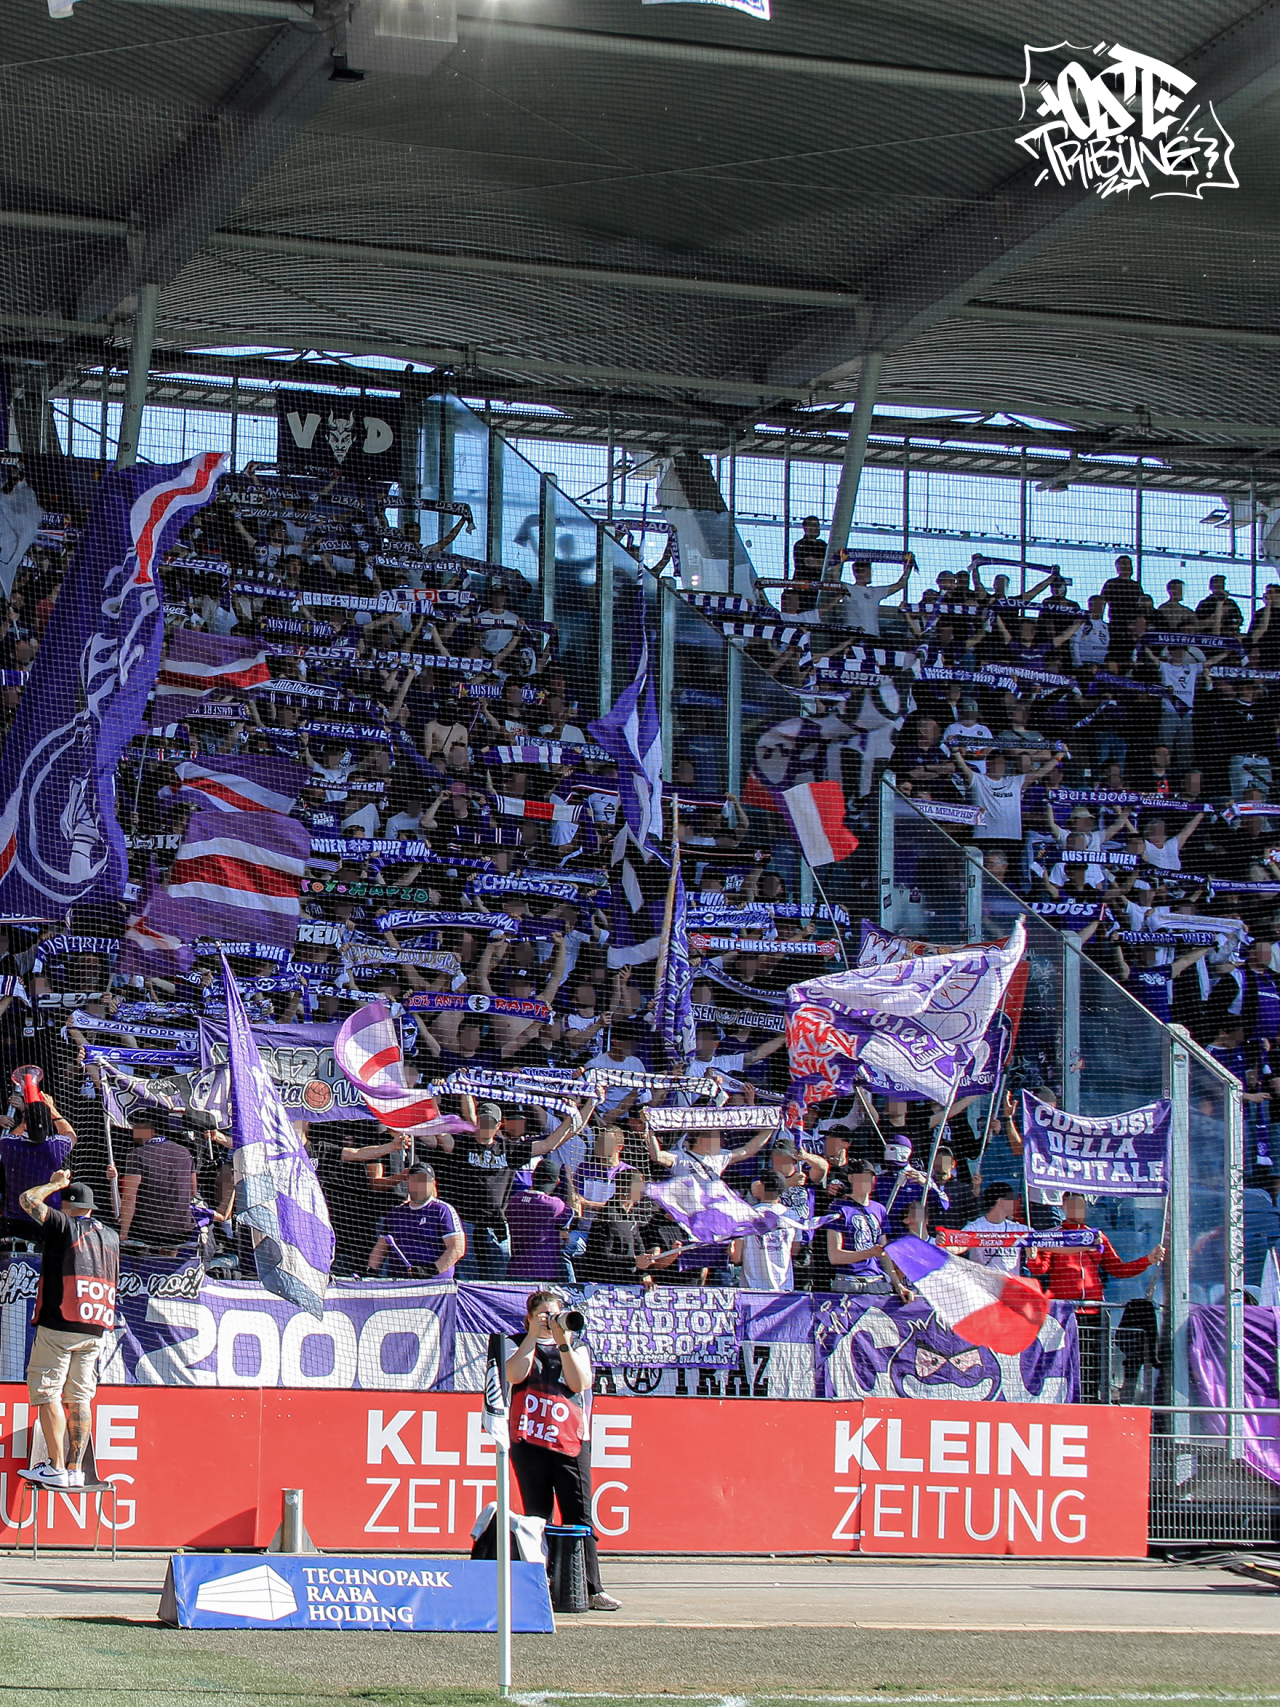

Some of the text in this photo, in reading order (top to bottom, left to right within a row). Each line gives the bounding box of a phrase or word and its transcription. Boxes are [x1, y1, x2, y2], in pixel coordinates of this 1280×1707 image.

[1157, 634, 1197, 646] AUSTRIA
[304, 646, 355, 659] AUST
[303, 722, 358, 736] USTRIA
[1062, 850, 1138, 866] AUSTRIA WIEN
[1030, 902, 1097, 917] LDOGS
[435, 995, 465, 1008] ANTI
[1033, 1104, 1157, 1139] CONFUSI
[1047, 1128, 1138, 1160] DELLA
[1030, 1152, 1165, 1183] CAPITALE
[76, 1278, 117, 1301] FOO
[589, 1287, 738, 1311] GEGEN
[586, 1308, 739, 1334] STADION
[135, 1298, 443, 1391] 2000
[587, 1332, 739, 1356] VERBOTE
[524, 1393, 570, 1423] OTO
[366, 1408, 633, 1469] KLEE
[833, 1417, 1090, 1479] KLEINE
[364, 1477, 631, 1537] ZEITG
[832, 1484, 1088, 1545] ZEITUNG
[301, 1567, 454, 1589] TECHNOPARK
[306, 1586, 380, 1605] RAABA
[308, 1604, 415, 1625] HOLDING
